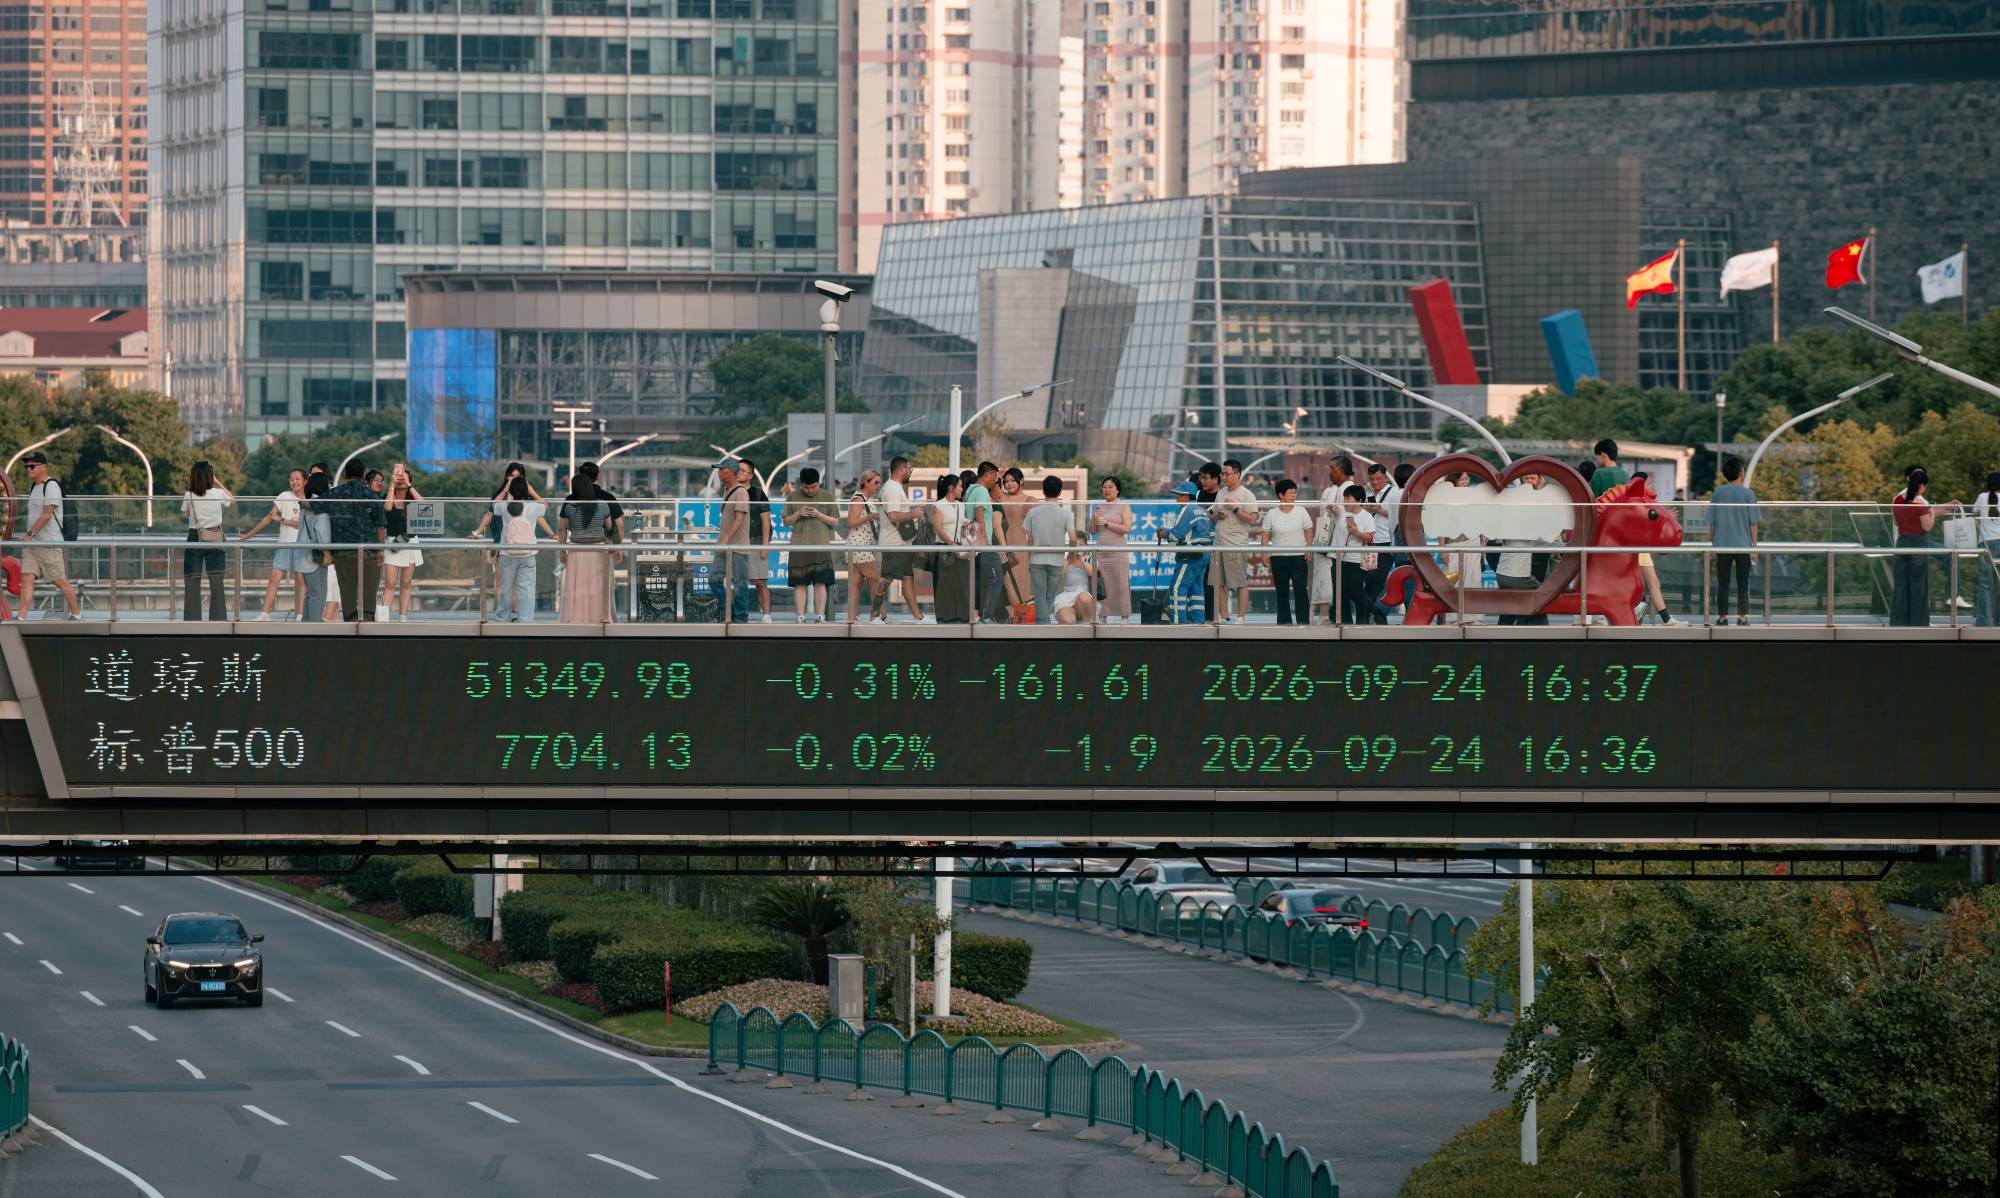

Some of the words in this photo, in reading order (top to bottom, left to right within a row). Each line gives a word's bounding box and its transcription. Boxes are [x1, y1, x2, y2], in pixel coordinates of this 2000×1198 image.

[85, 650, 267, 702] 道琼斯
[466, 662, 692, 700] 51349.98
[766, 663, 936, 700] -0.31%
[959, 663, 1149, 700] -161.61
[1203, 664, 1486, 701] 2026-09-24
[1521, 664, 1658, 701] 16:37
[88, 722, 306, 775] 标普500
[496, 733, 692, 770] 7704.13
[766, 733, 936, 771] -0.02%
[1044, 734, 1158, 771] -1.9
[1202, 734, 1484, 772] 2026-09-24
[1519, 735, 1657, 773] 16:36
